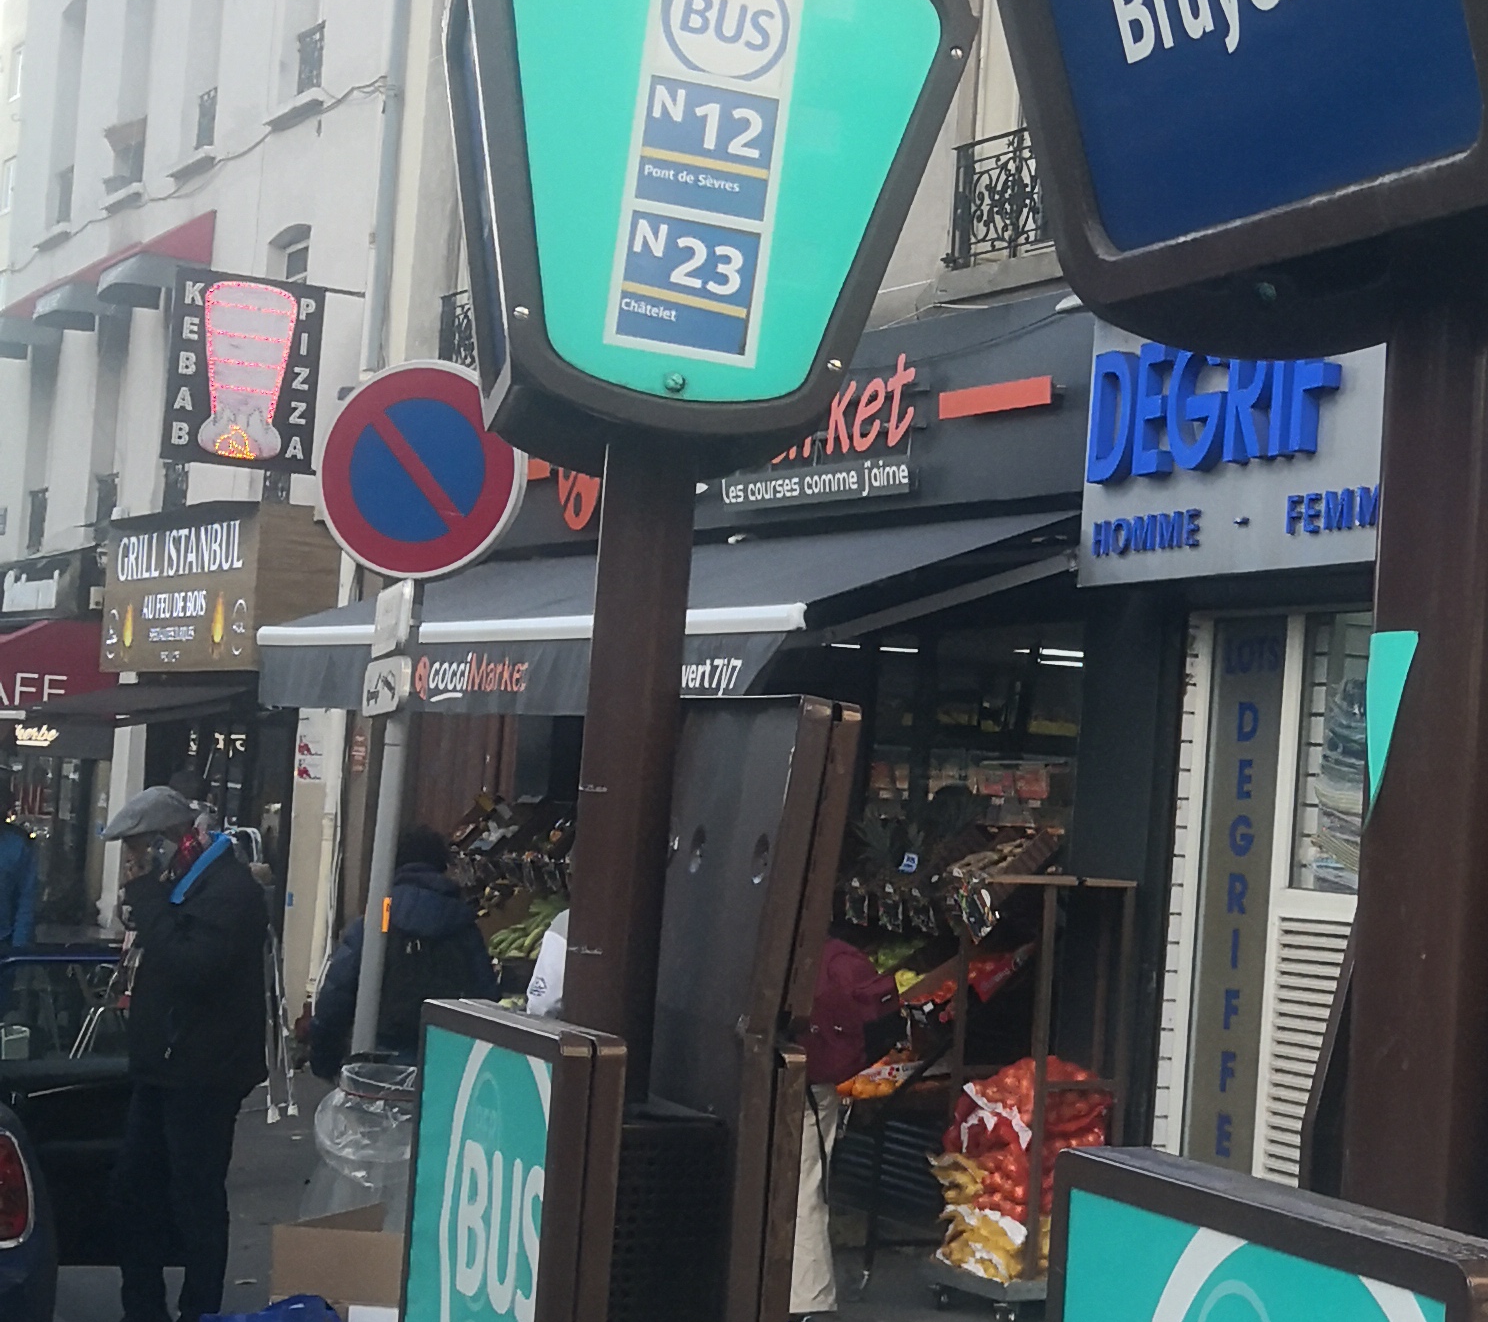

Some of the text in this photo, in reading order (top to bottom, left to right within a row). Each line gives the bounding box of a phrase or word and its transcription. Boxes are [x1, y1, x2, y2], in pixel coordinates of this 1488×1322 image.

[644, 164, 741, 193] Pont de Sèvres
[621, 297, 677, 323] Châtelet
[170, 281, 206, 446] KEBAB
[284, 298, 316, 460] PIZZA
[748, 478, 800, 502] courses
[804, 469, 858, 494] comme
[861, 460, 909, 497] j'aime
[1092, 508, 1201, 557] HOMME
[1286, 485, 1380, 535] FEMM
[118, 519, 243, 581] GRILL ISTANBUL
[142, 589, 207, 619] AU FEU DE BOIS
[681, 659, 711, 689] vert
[1214, 701, 1260, 1158] DEGRIFFE
